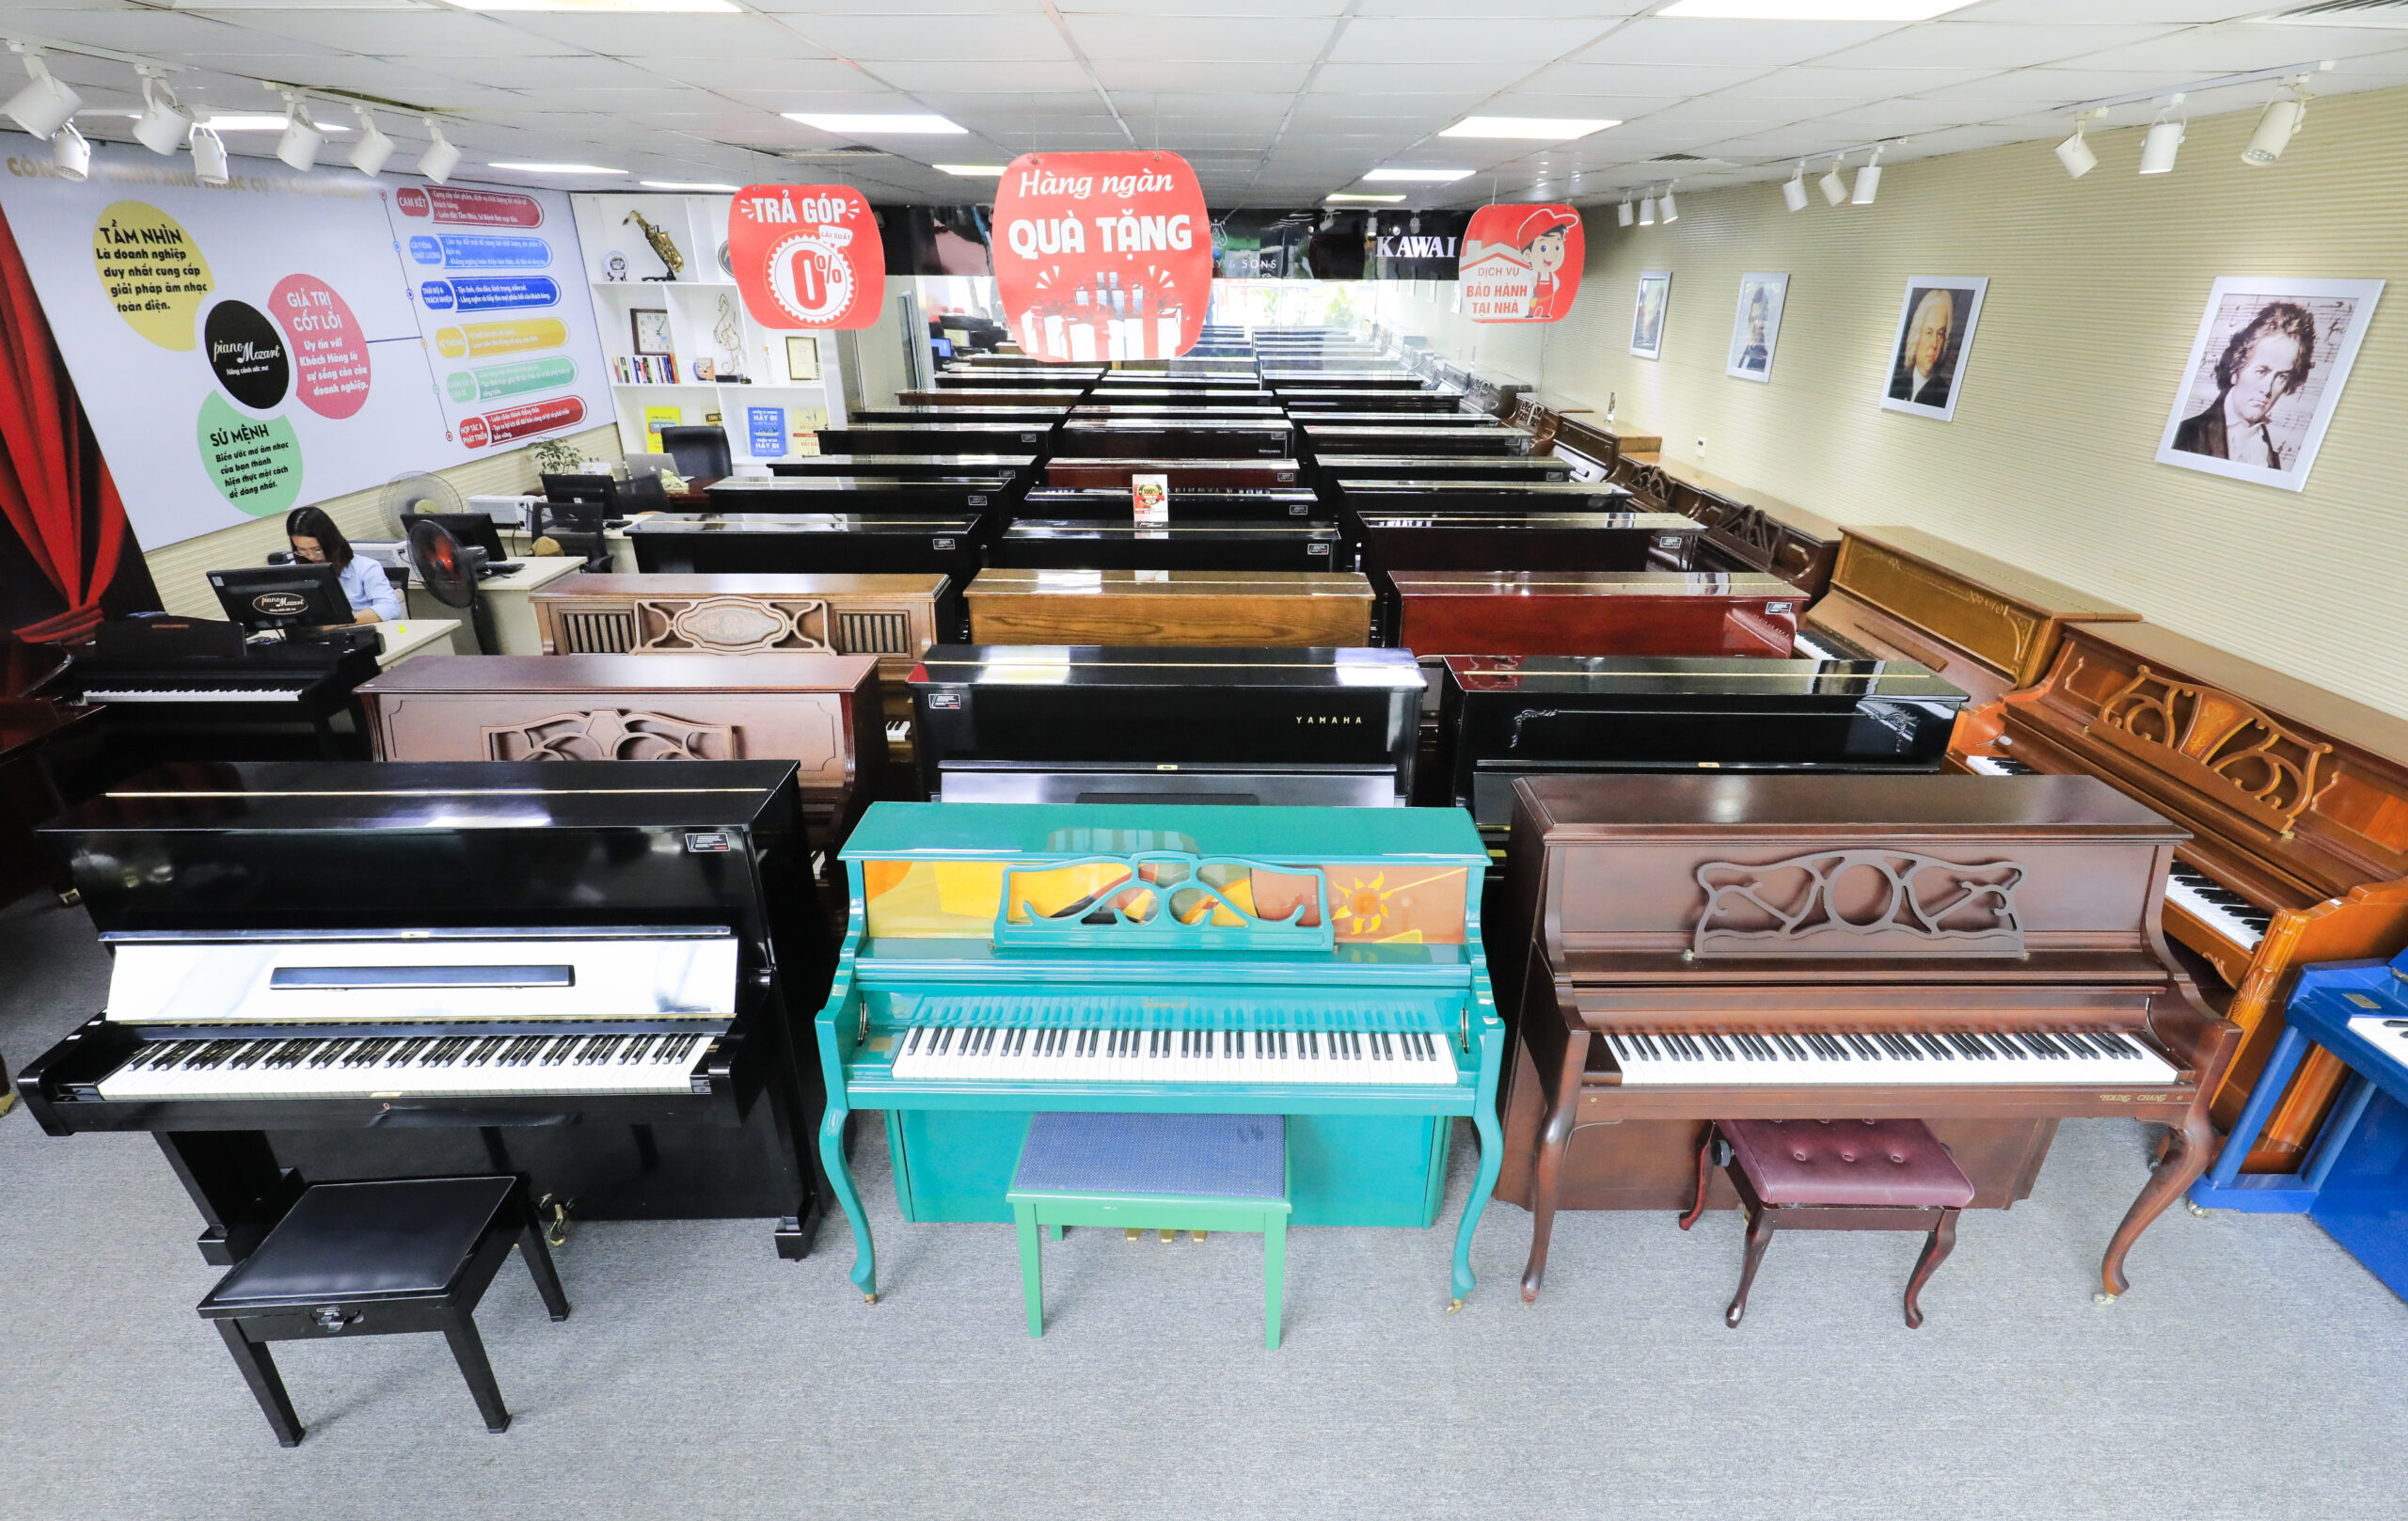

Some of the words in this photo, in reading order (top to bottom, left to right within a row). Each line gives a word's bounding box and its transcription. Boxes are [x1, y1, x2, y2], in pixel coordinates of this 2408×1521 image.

[1019, 169, 1093, 199] Hàng
[1101, 168, 1174, 198] ngàn
[752, 189, 798, 223] TRẢ
[801, 193, 847, 223] GÓP
[100, 219, 139, 244] TẦM
[140, 224, 183, 244] NHÌN
[1008, 210, 1085, 260] QUÀ
[1096, 208, 1192, 261] TẶNG
[96, 248, 111, 260] Là
[114, 248, 149, 259] doanh
[151, 247, 186, 261] nghiệp
[1375, 236, 1457, 258] KAWAI
[103, 266, 124, 279] duy
[128, 263, 152, 276] nhất
[155, 267, 180, 277] cung
[182, 262, 200, 277] cấp
[1242, 259, 1276, 269] SONS
[1478, 267, 1502, 277] DỊCH
[1506, 267, 1520, 277] VỤ
[791, 249, 843, 310] 0%
[111, 283, 132, 297] giải
[135, 282, 162, 295] pháp
[166, 282, 181, 293] âm
[184, 282, 207, 294] nhạc
[287, 288, 310, 308] GIÁ
[309, 291, 333, 309] TRỊ
[1466, 282, 1491, 297] BẢO
[1494, 283, 1528, 297] HÀNH
[117, 301, 142, 312] toàn
[145, 299, 170, 313] diện.
[1472, 302, 1491, 317] TẠI
[1494, 299, 1519, 314] NHÀ
[293, 309, 319, 331] CỐT
[320, 310, 343, 329] LÕI
[214, 340, 244, 362] piano
[236, 341, 280, 364] Mozart
[304, 340, 315, 352] Uy
[318, 339, 329, 349] tín
[330, 337, 342, 348] với
[299, 354, 325, 366] Khách
[326, 353, 349, 364] Hàng
[318, 367, 338, 380] sống
[339, 366, 352, 377] còn
[354, 364, 367, 374] của
[313, 383, 339, 396] doanh
[341, 379, 369, 393] nghiệp.
[210, 427, 229, 447] SỨ
[230, 423, 269, 445] MỆNH
[215, 452, 232, 463] Biến
[233, 449, 246, 459] ước
[248, 447, 259, 455] mơ
[273, 441, 289, 451] nhạc
[220, 465, 233, 474] của
[235, 463, 249, 472] bạn
[251, 456, 271, 467] thành
[225, 477, 241, 487] hiện
[242, 473, 257, 483] thực
[259, 469, 272, 479] một
[273, 465, 288, 475] cách
[229, 486, 238, 499] dễ
[240, 486, 259, 497] dàng
[260, 479, 277, 491] nhất.
[1296, 716, 1362, 724] YAMAHA
[2099, 1094, 2131, 1103] YOUNG
[2136, 1094, 2167, 1103] CHANG
